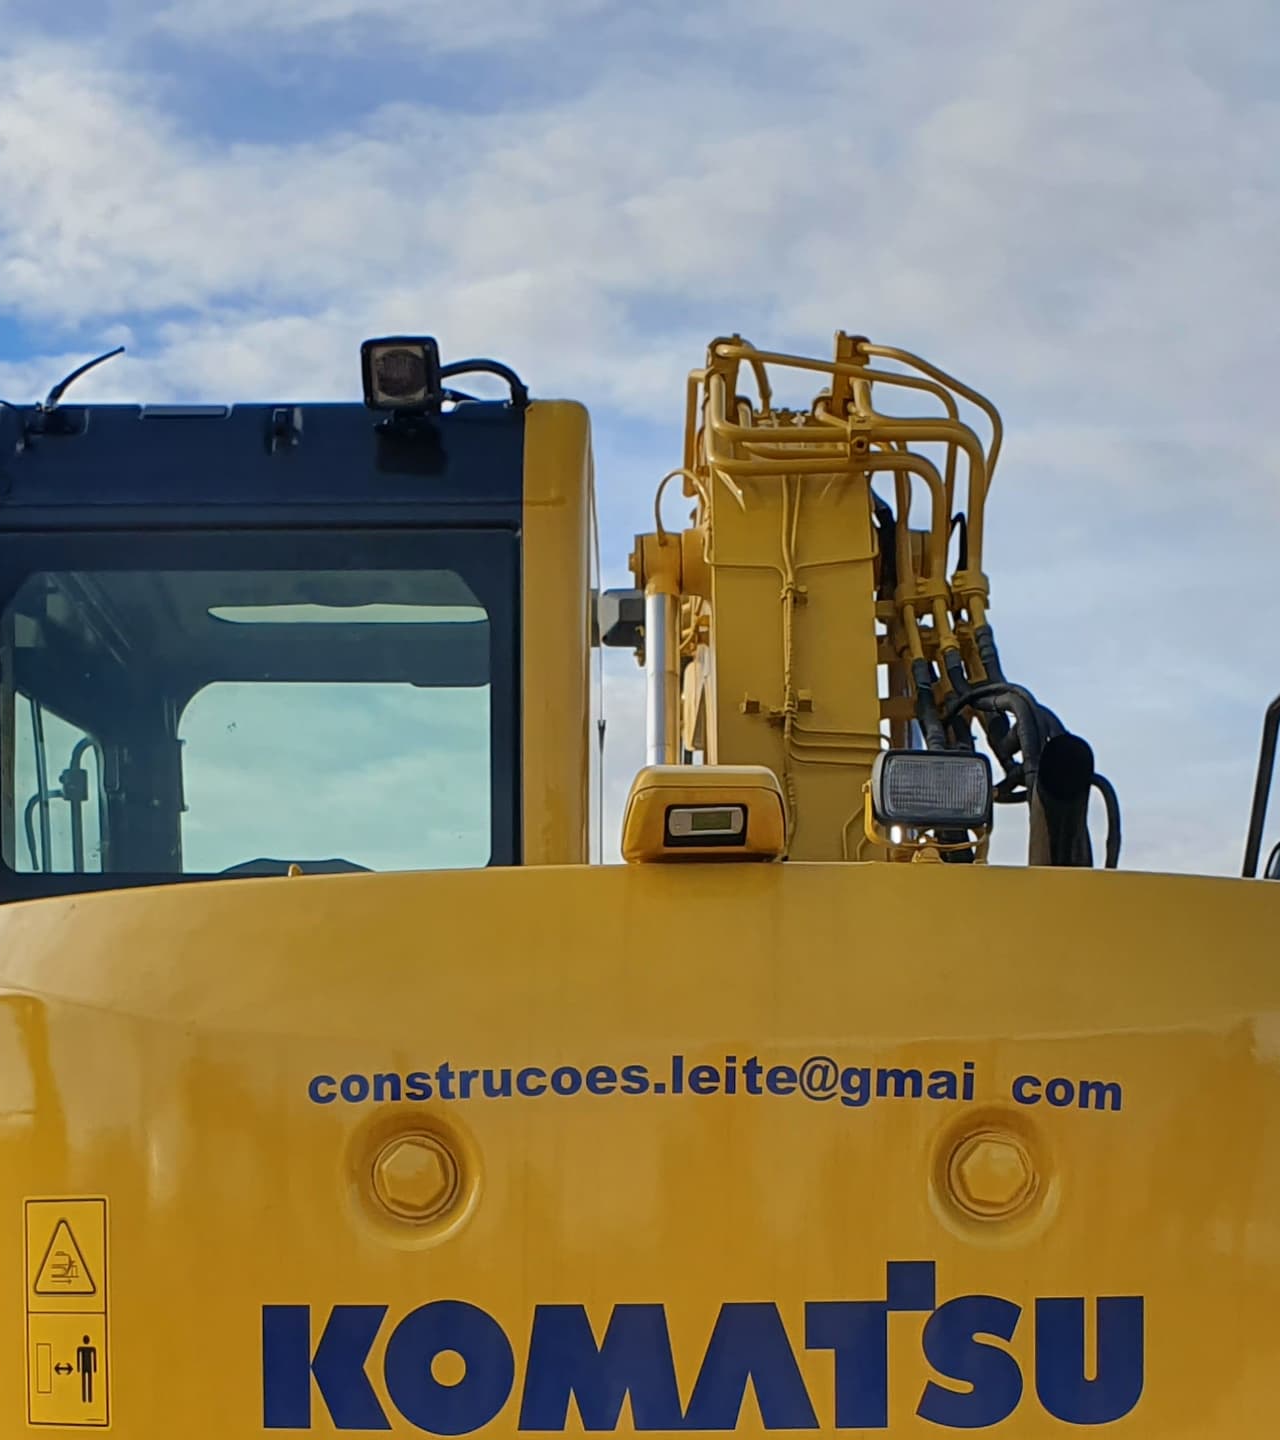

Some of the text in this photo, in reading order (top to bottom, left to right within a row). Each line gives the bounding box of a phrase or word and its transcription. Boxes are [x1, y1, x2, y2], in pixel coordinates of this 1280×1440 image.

[307, 1055, 1123, 1111] construcoes.leite@gmai com
[261, 1260, 1145, 1437] KOMATSU
